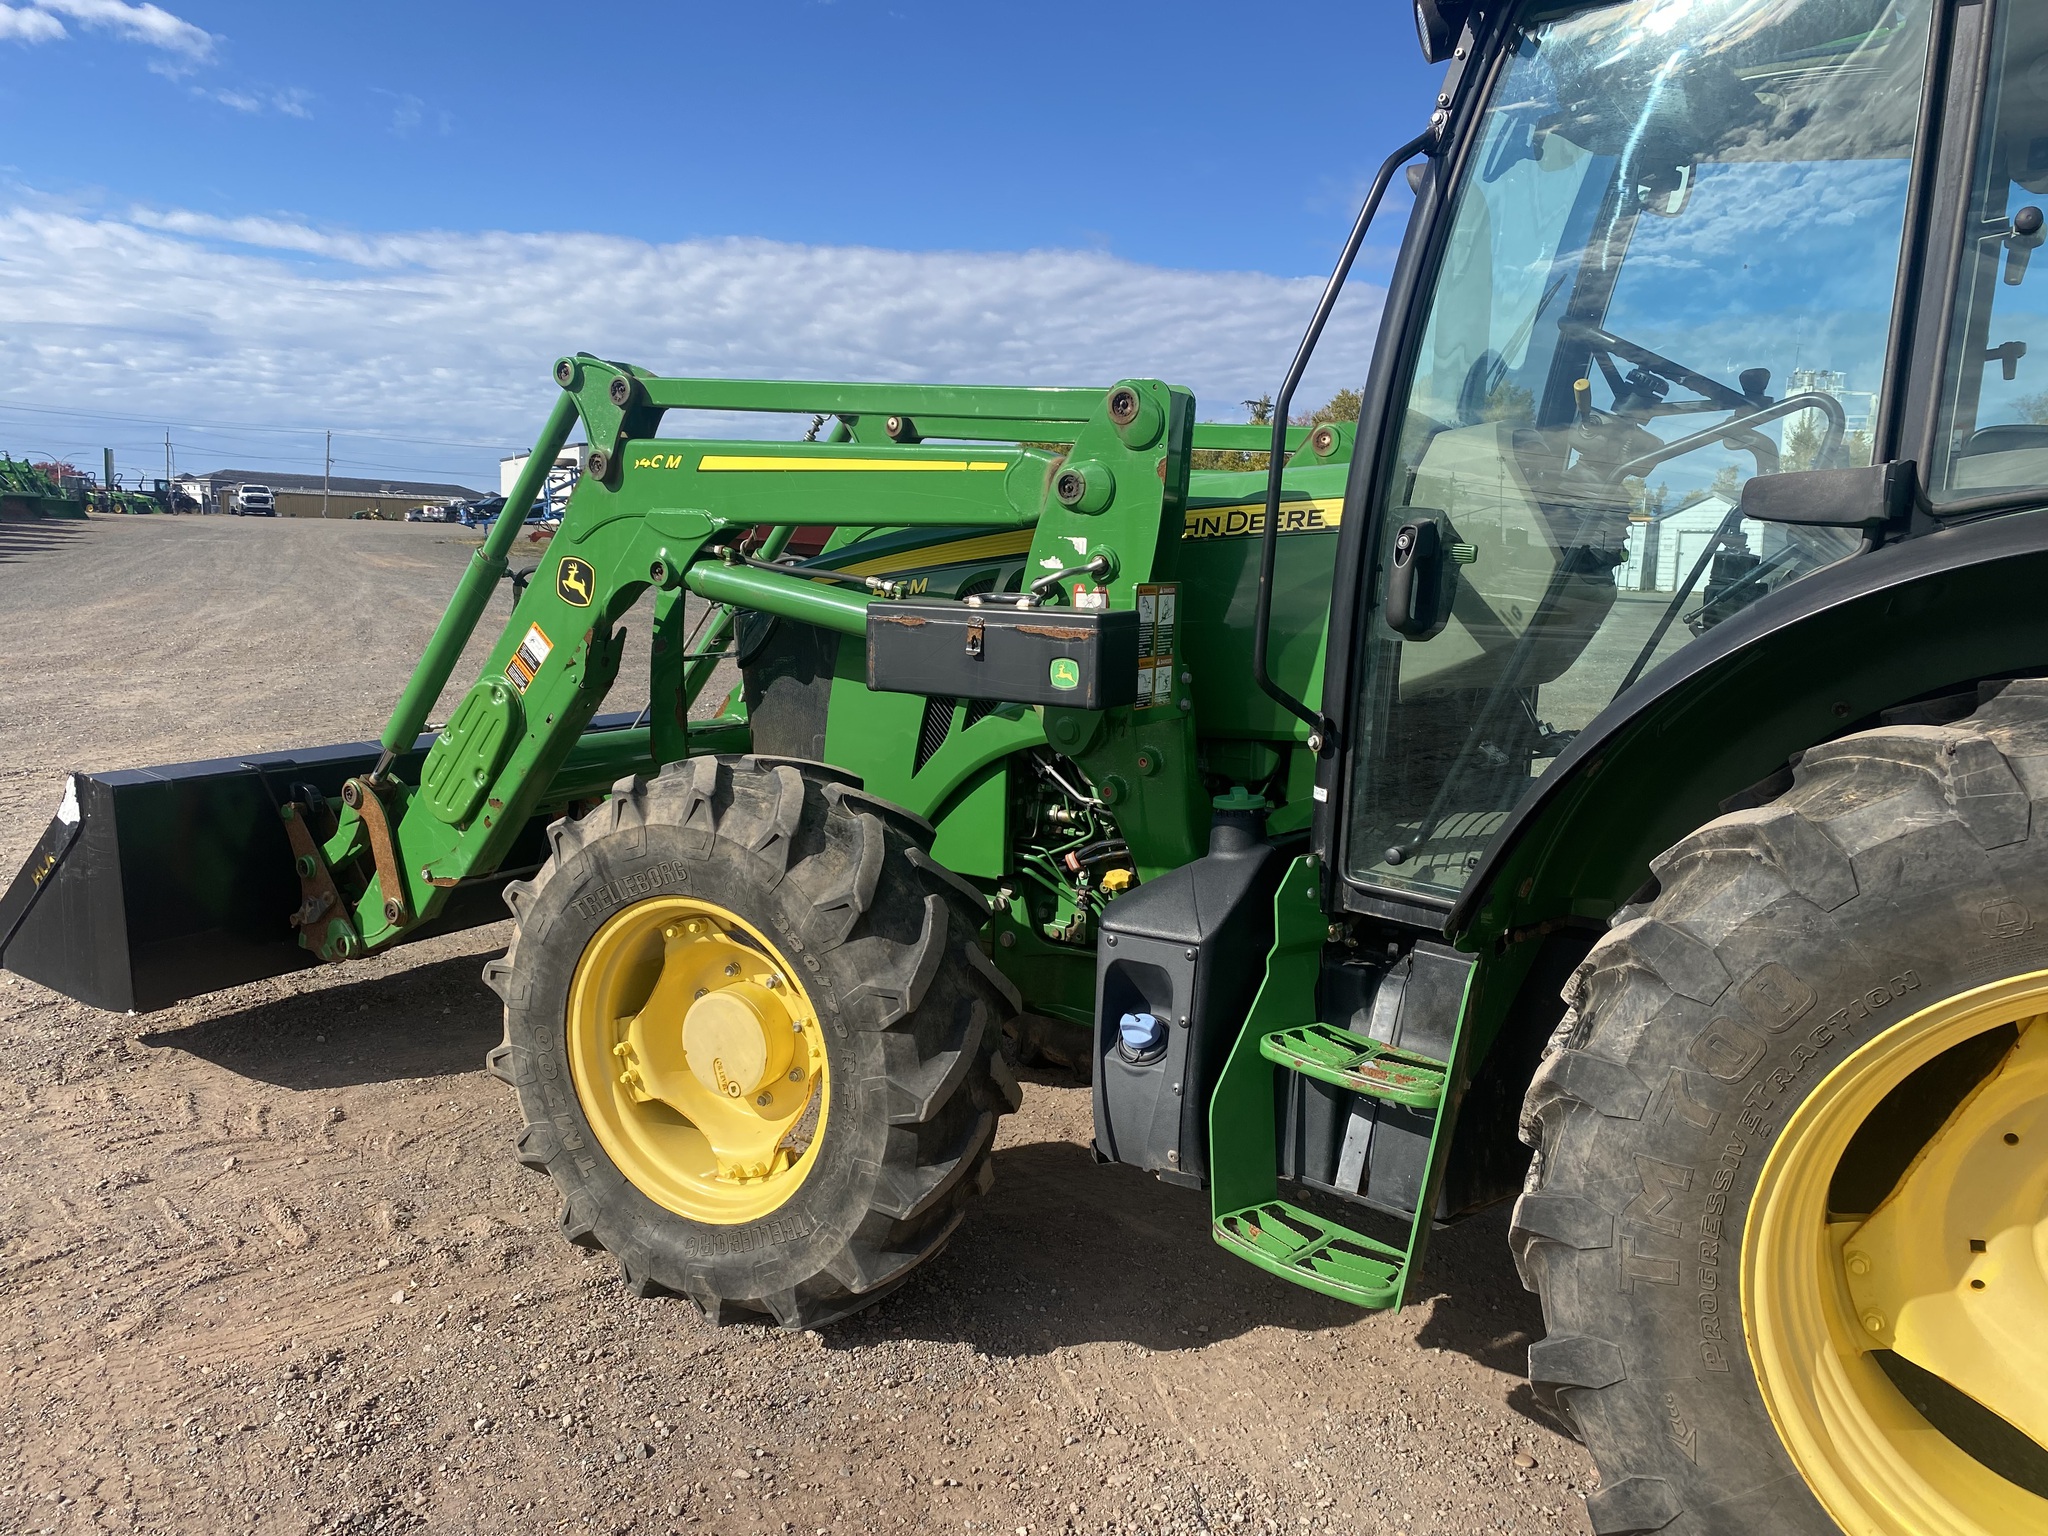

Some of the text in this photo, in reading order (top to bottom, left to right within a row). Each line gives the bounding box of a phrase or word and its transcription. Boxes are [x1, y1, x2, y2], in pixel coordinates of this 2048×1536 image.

[1184, 515, 1221, 536] HN
[570, 858, 688, 921] TRELLEBORG
[684, 1212, 811, 1259] TRELLEBORG
